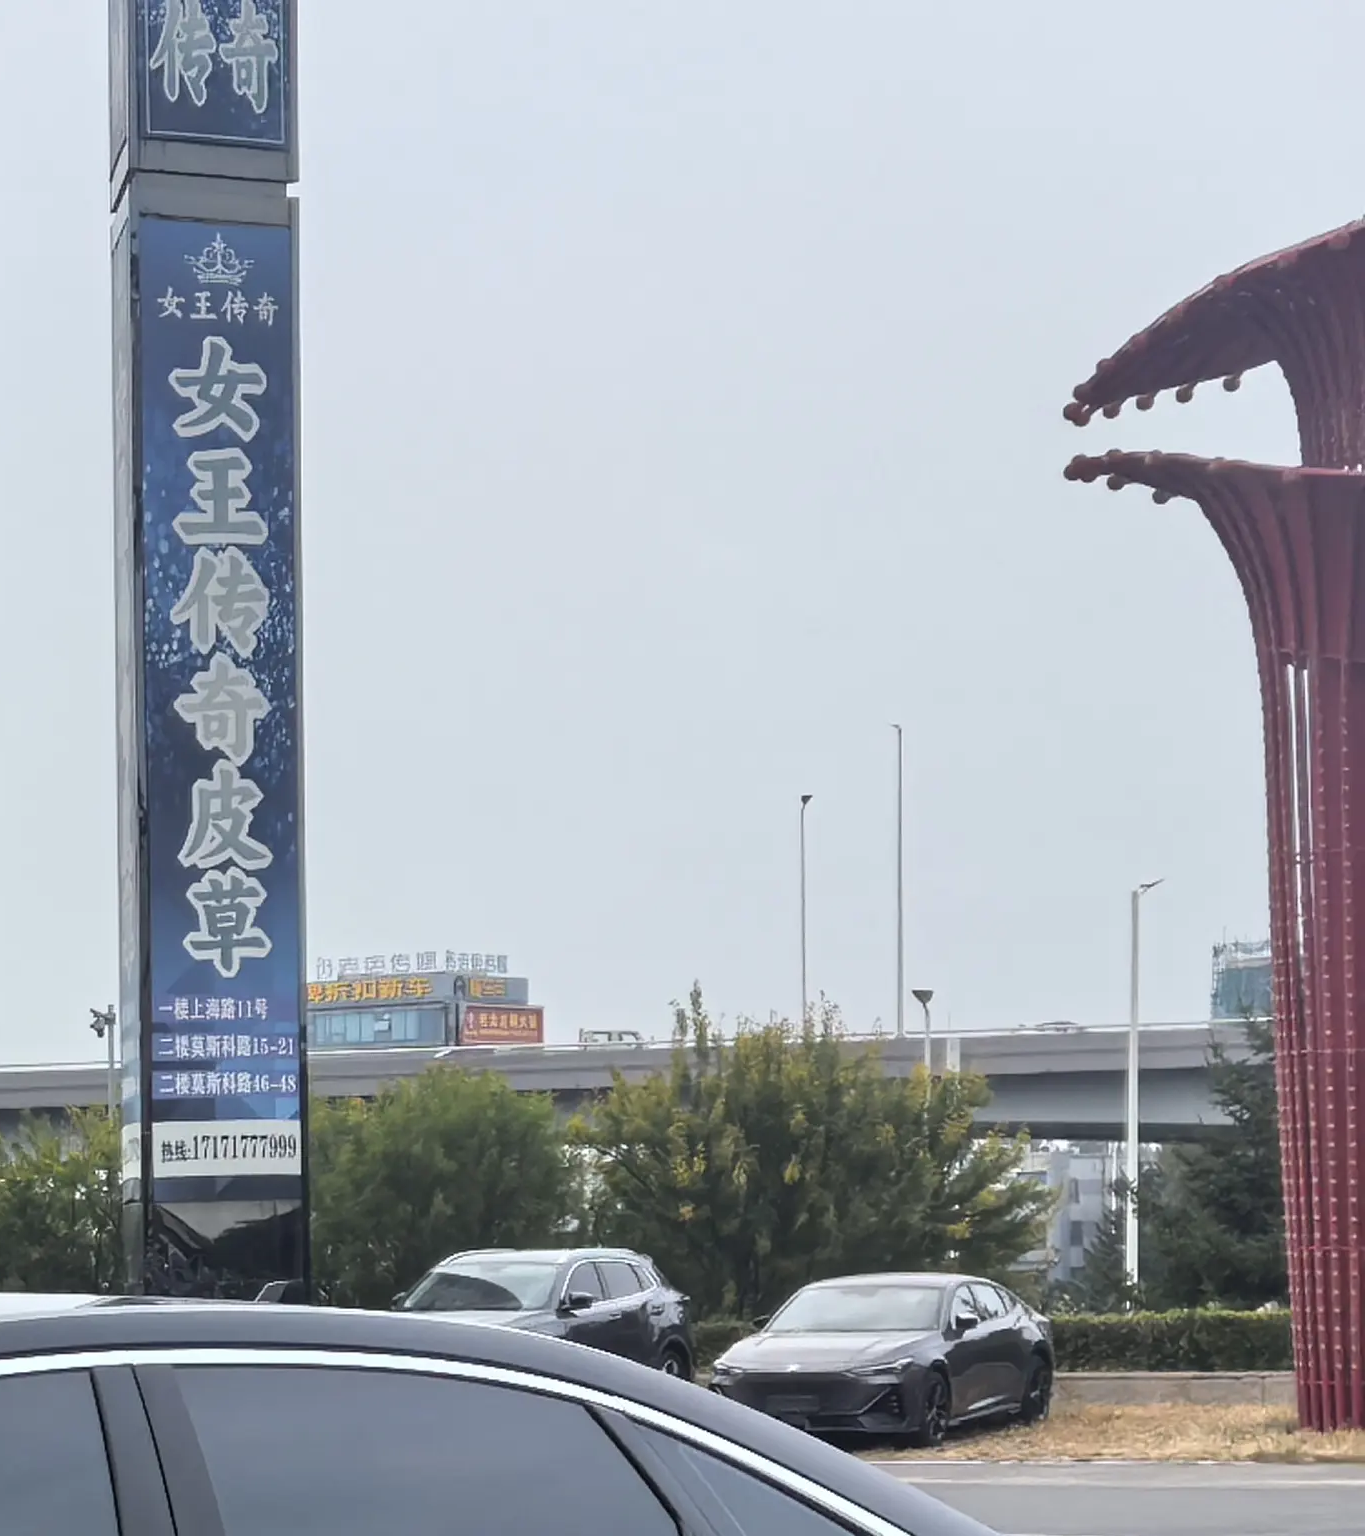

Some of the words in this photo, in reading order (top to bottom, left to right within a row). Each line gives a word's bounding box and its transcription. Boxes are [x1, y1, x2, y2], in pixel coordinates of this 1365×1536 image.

[157, 285, 279, 326] 女王传奇
[169, 336, 274, 978] 女王传奇皮草
[158, 997, 268, 1020] 一楼上海路11号
[158, 1033, 294, 1059] 二楼莫斯科路15-21
[159, 1071, 297, 1096] 二楼莫斯科路46-48
